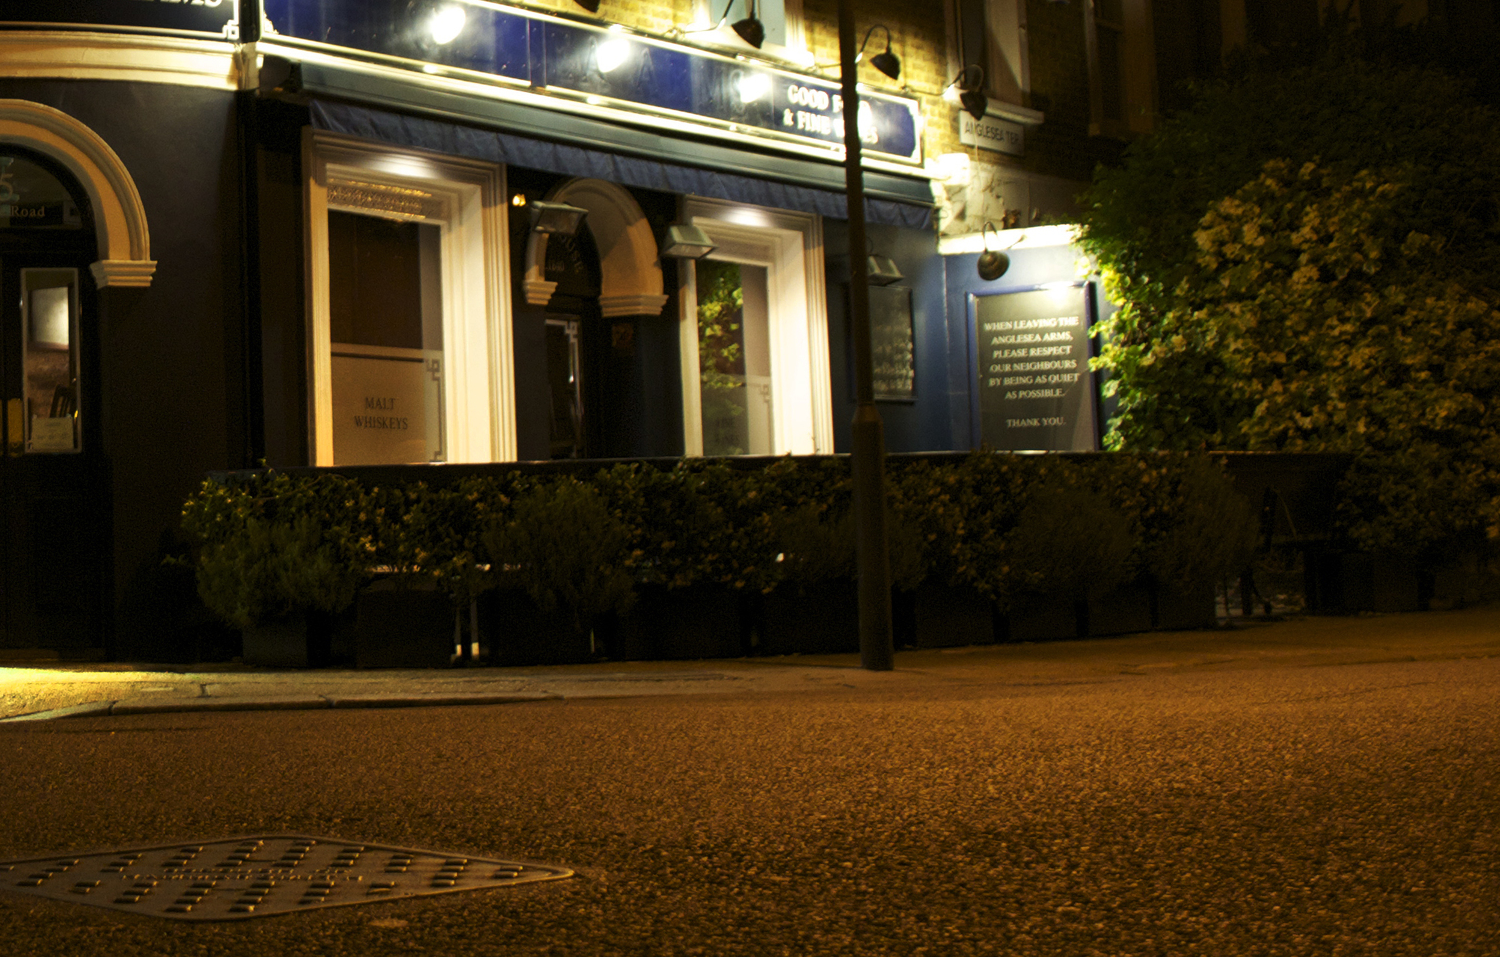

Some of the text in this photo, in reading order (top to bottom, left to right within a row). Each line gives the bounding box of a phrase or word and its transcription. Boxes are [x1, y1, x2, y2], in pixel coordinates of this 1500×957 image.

[787, 84, 830, 111] GOOD
[783, 108, 795, 127] &
[797, 110, 831, 135] FINE
[11, 204, 46, 218] Road
[984, 316, 1079, 331] WHEN LEAVING THE
[991, 333, 1041, 345] ANGLESEA
[992, 345, 1072, 359] PLEASE RESPECT
[990, 359, 1077, 373] OUR NEIGHBOURS
[988, 372, 1080, 387] BY BEING AS QUIET
[1005, 390, 1017, 400] AS
[365, 397, 396, 410] MALT
[354, 415, 408, 430] WHISKEYS
[1006, 418, 1040, 428] THANK
